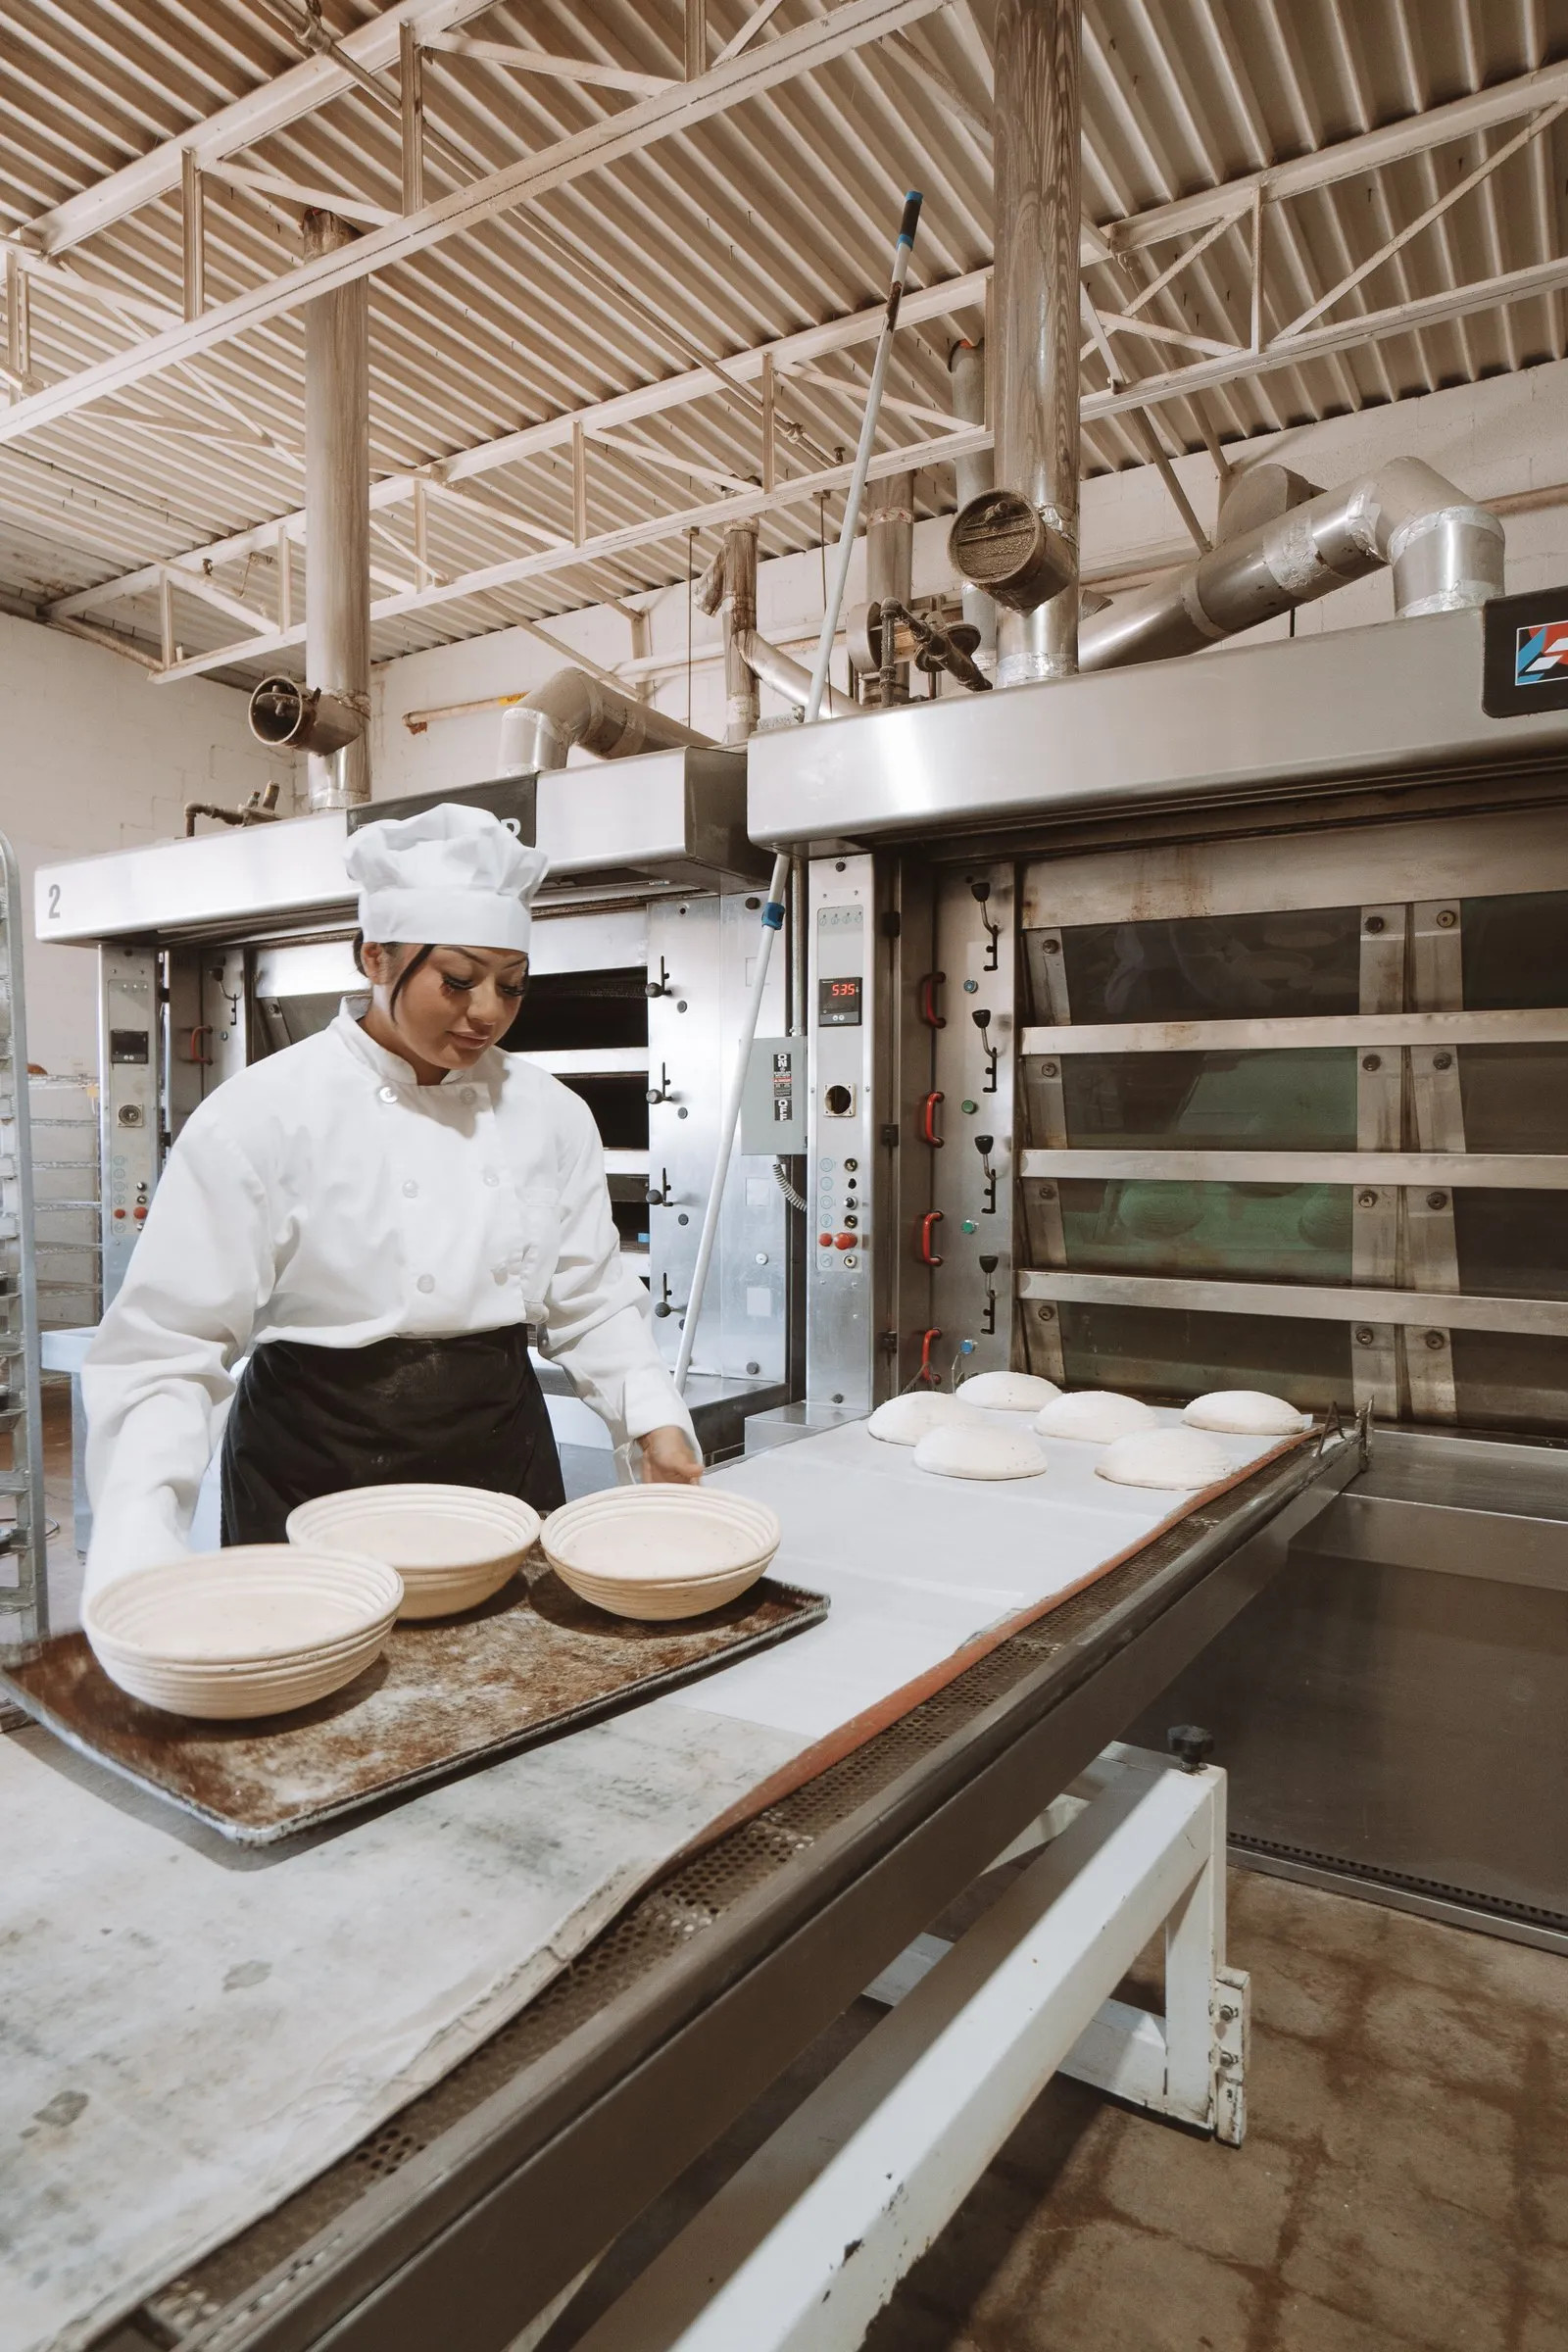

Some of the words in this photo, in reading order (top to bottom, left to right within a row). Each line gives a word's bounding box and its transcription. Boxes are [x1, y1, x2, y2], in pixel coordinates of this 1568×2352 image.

[49, 884, 61, 919] 2
[832, 983, 856, 996] 535
[777, 1054, 788, 1067] ON
[778, 1099, 788, 1121] OFF
